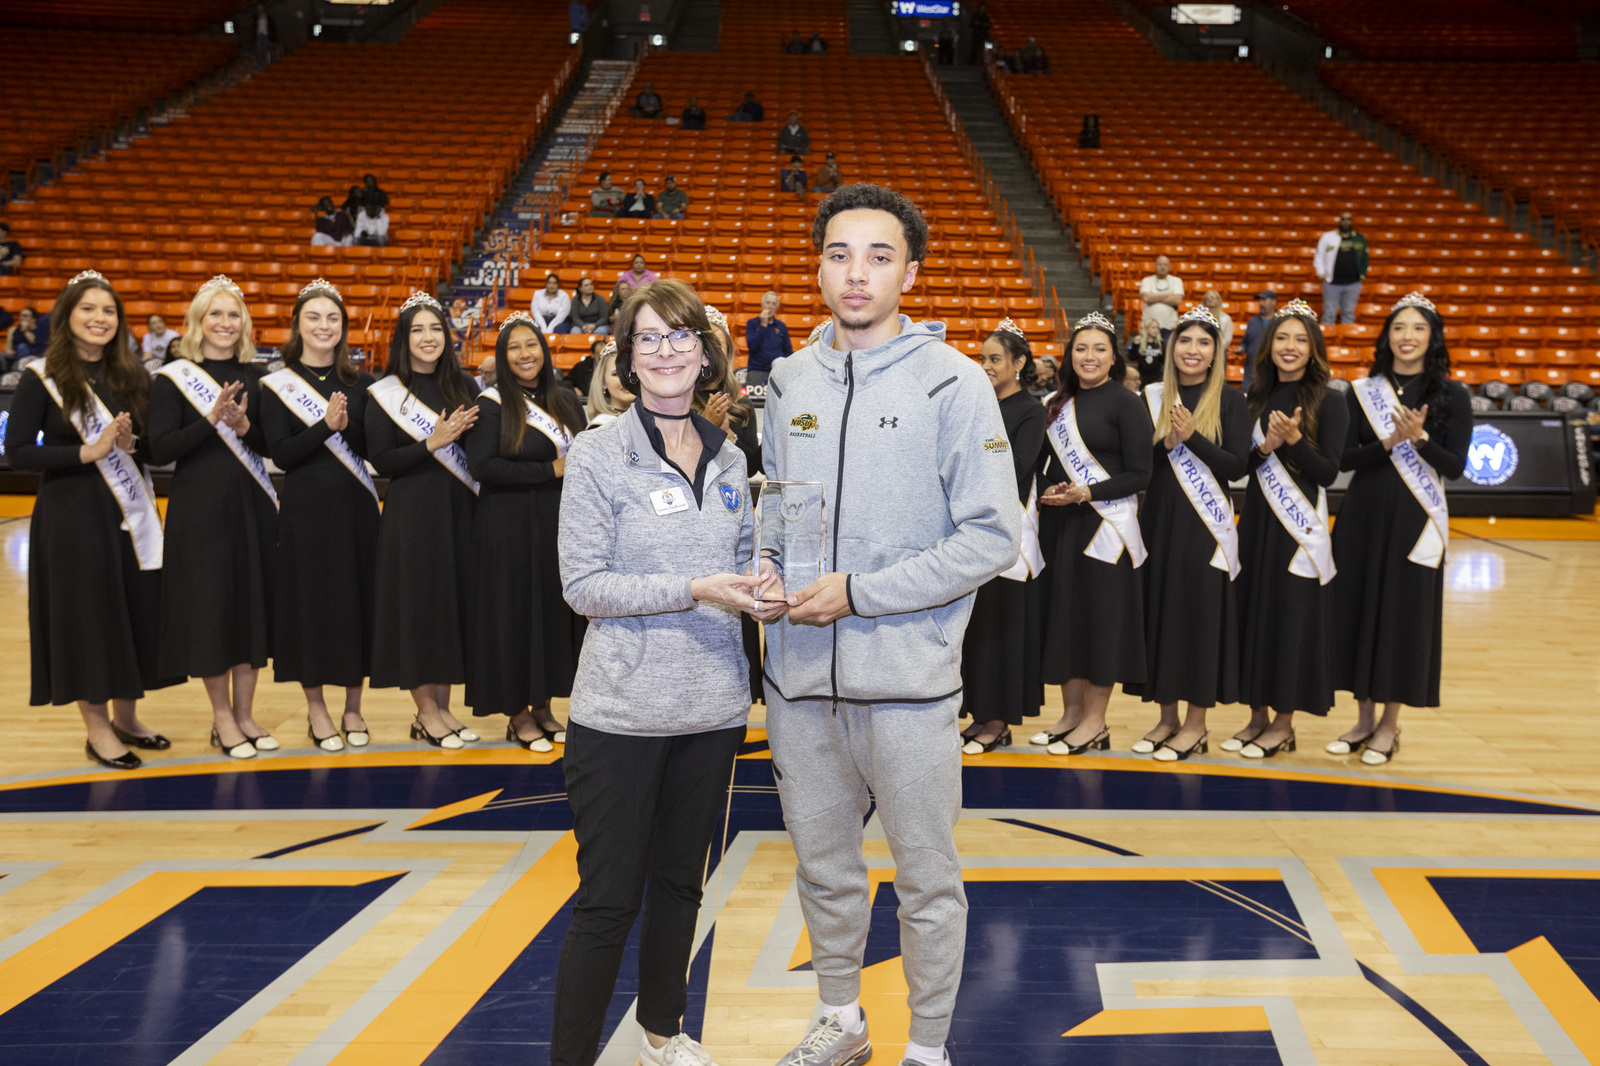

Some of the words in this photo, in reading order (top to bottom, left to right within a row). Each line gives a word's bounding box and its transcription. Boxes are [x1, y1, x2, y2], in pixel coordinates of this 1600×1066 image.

[187, 377, 216, 404] 2025
[297, 393, 324, 418] 2025
[411, 413, 436, 436] 2025
[1367, 387, 1388, 413] 2025
[1380, 411, 1397, 435] SU
[1056, 423, 1072, 448] SUN
[1180, 459, 1226, 523] PRINCESS
[1396, 441, 1442, 507] PRINCESS
[1262, 465, 1309, 528] PRINCESS
